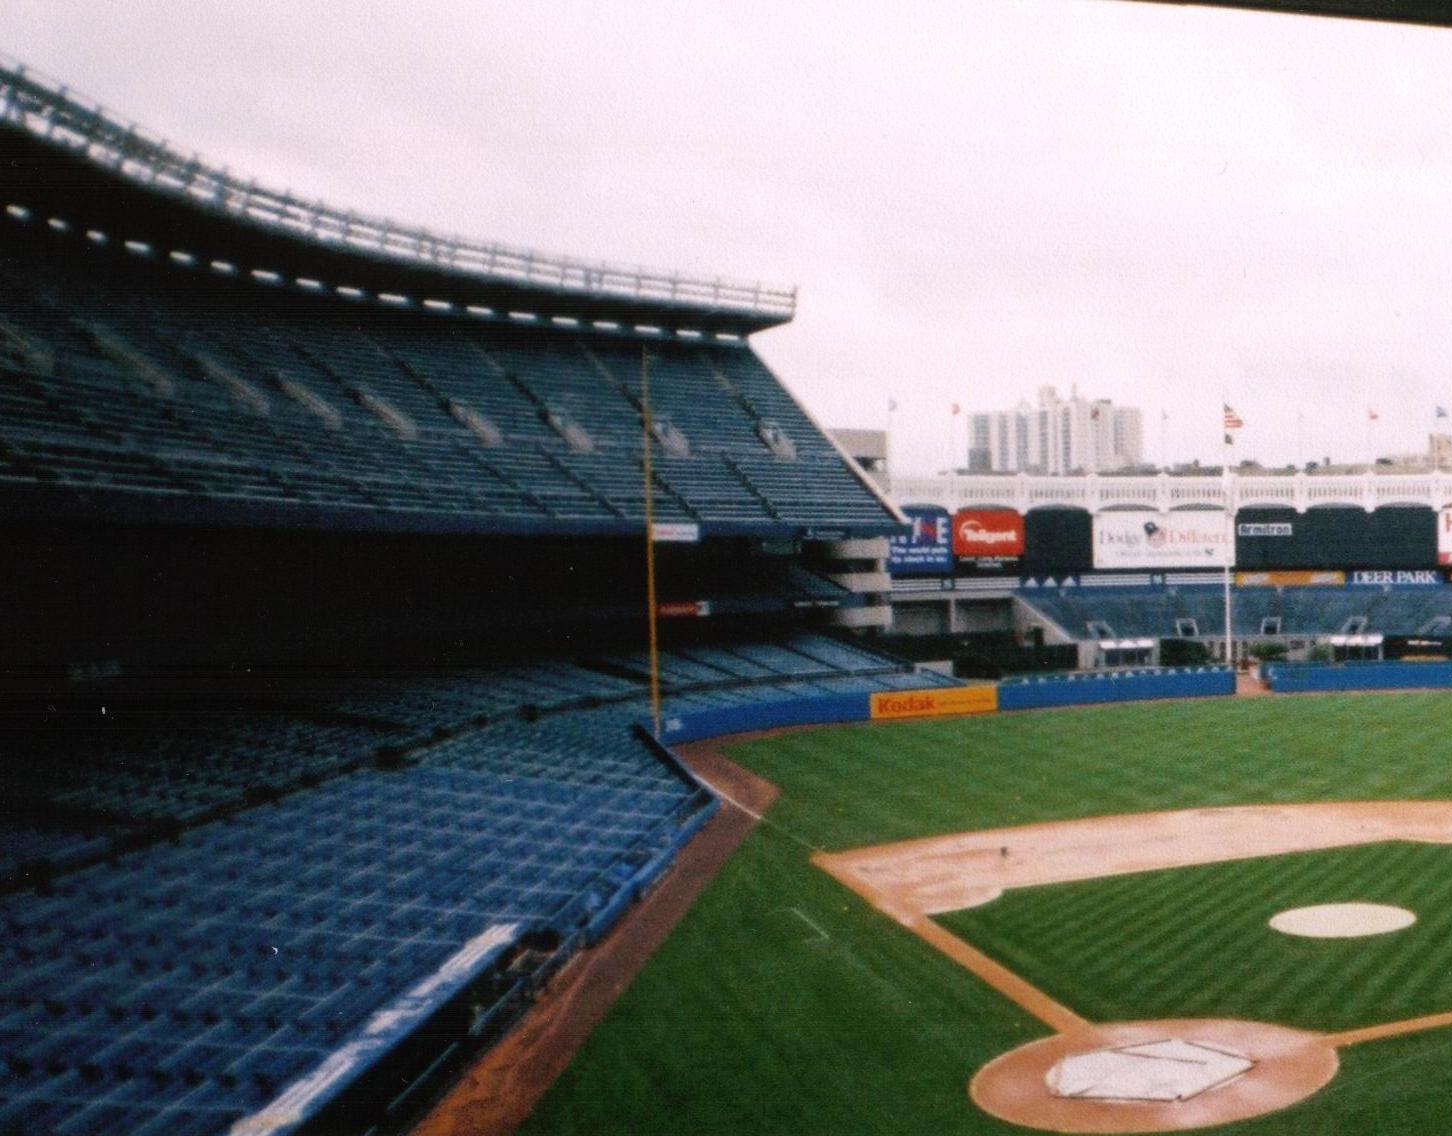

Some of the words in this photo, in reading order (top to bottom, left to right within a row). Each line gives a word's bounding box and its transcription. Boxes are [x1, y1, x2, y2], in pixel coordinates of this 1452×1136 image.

[963, 528, 1018, 544] Teligent
[1240, 525, 1291, 536] Armitron
[1353, 570, 1396, 584] DEER
[1397, 570, 1439, 583] PARK
[877, 696, 936, 713] Kodak
